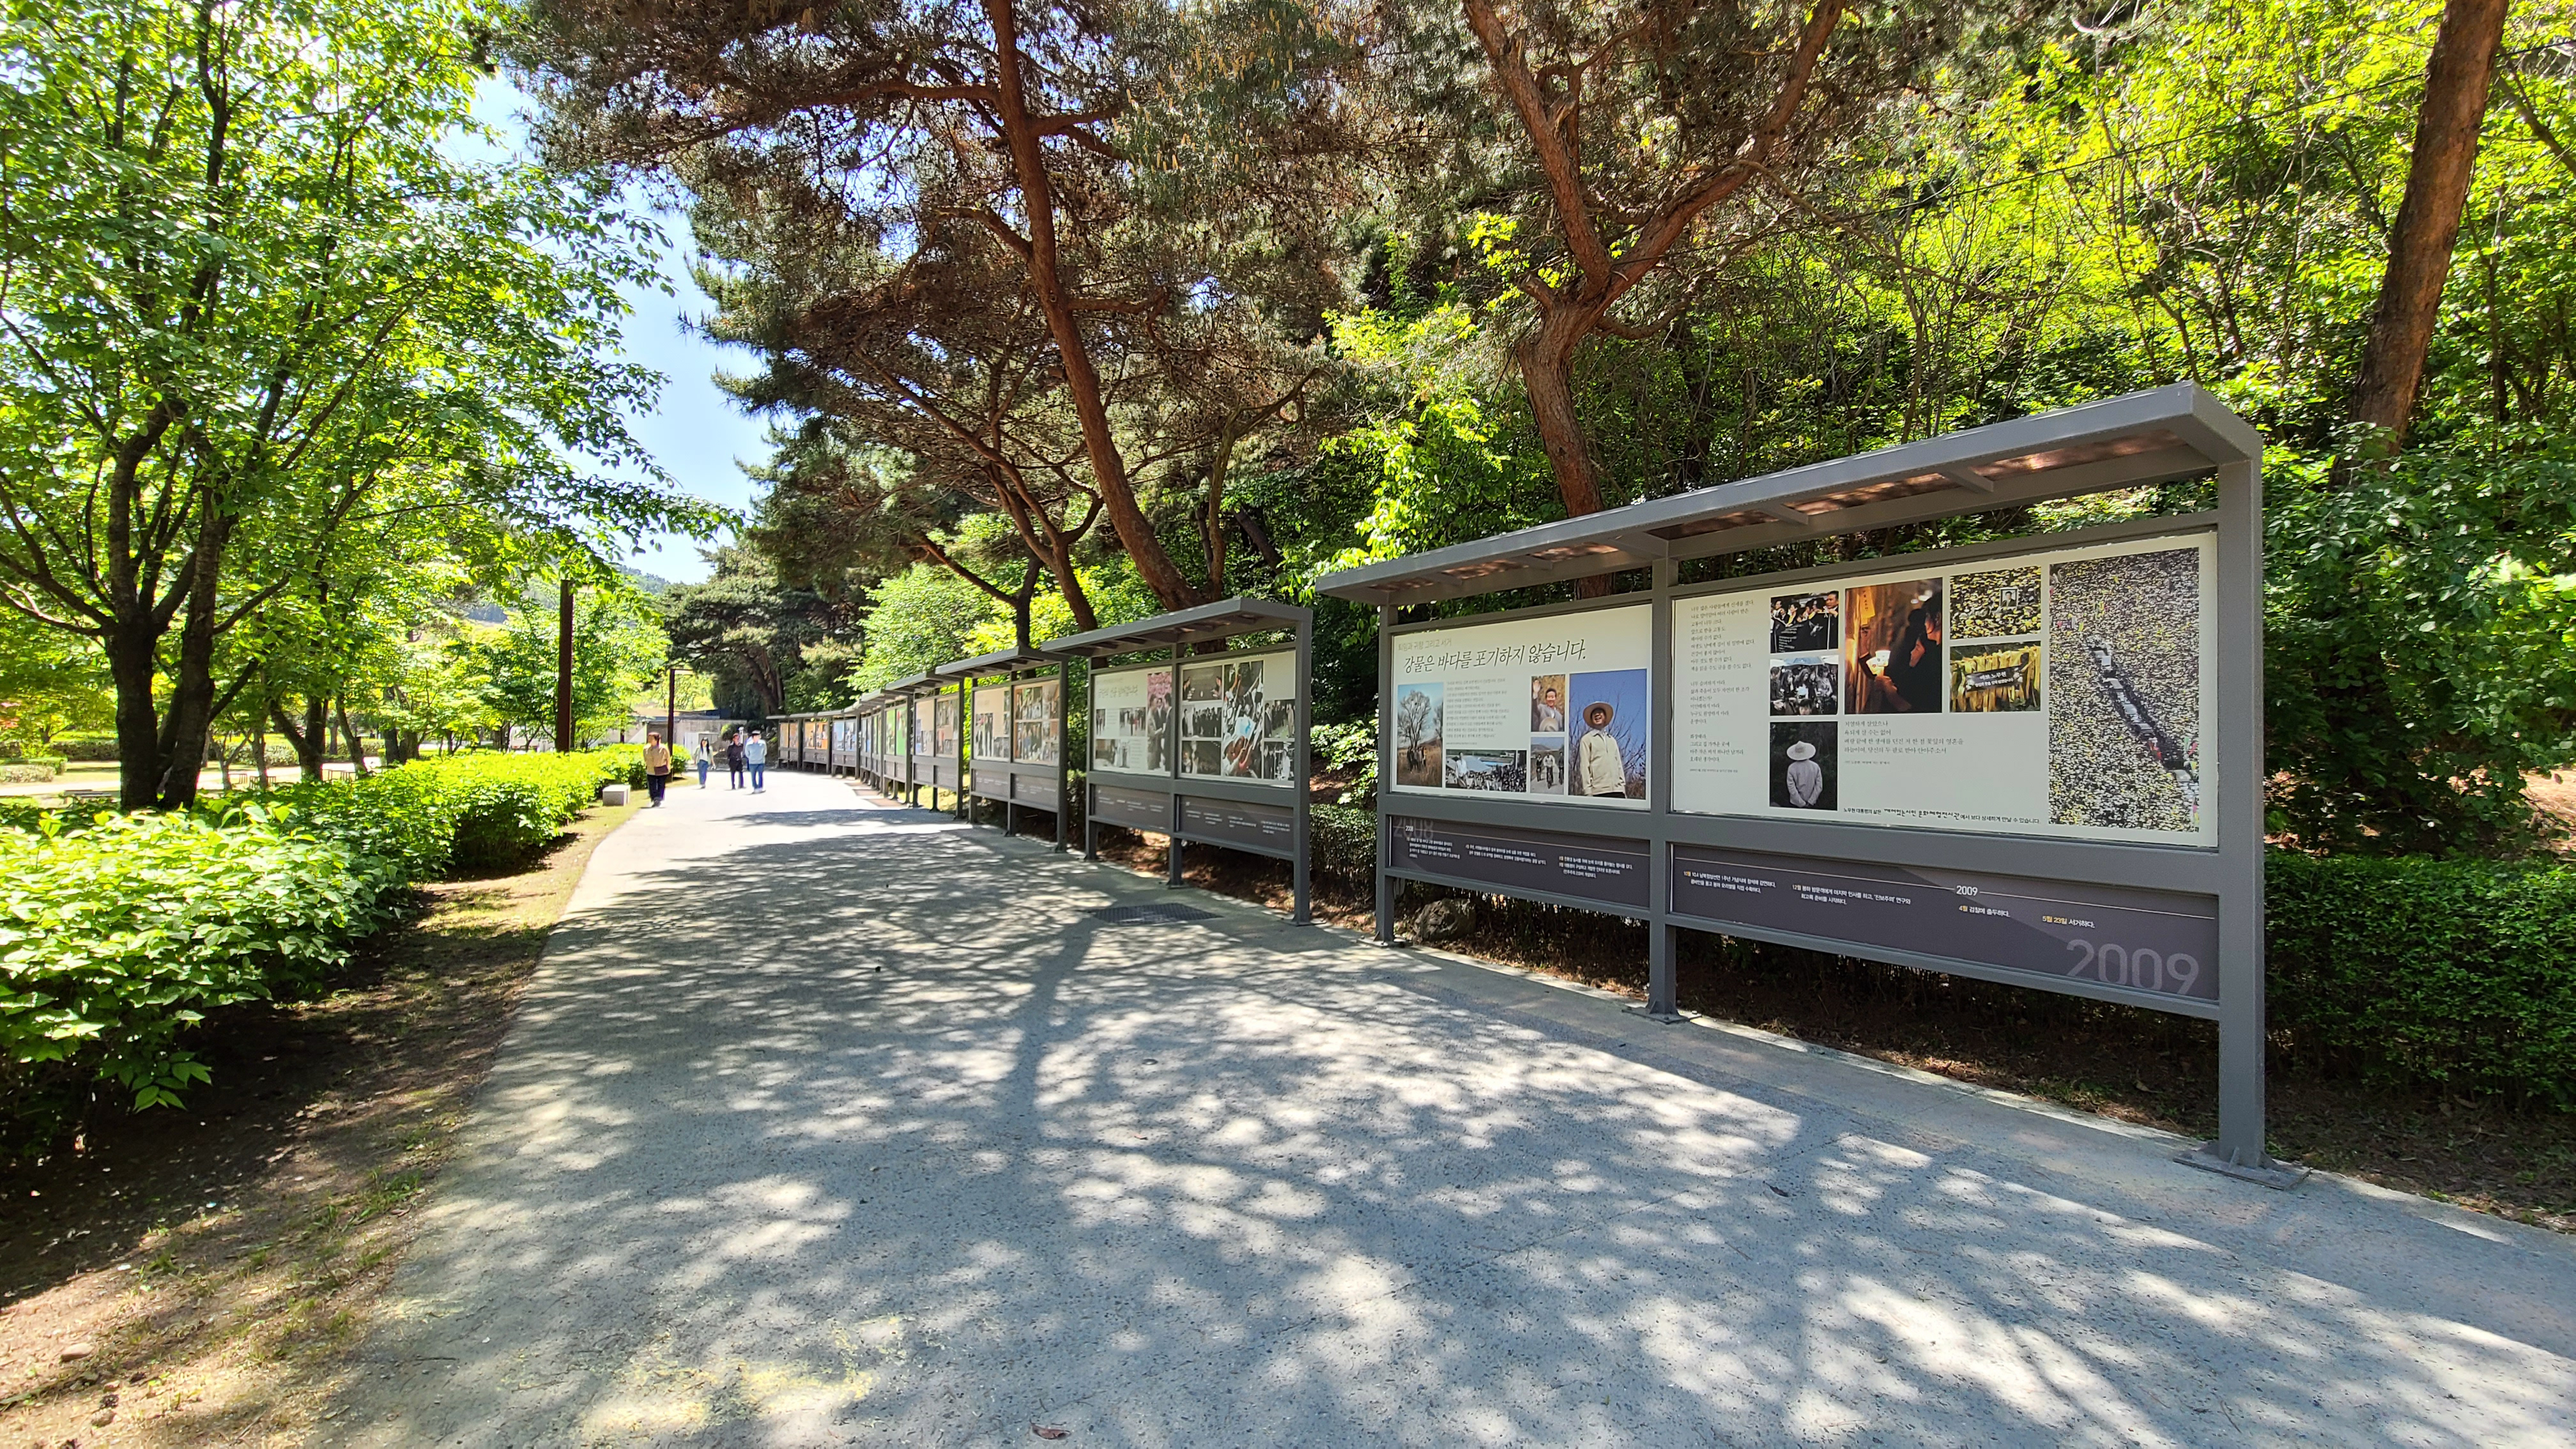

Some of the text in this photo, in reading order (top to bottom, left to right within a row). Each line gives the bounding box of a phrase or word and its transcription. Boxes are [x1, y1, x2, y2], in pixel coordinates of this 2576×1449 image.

[1424, 640, 1439, 648] 그리고
[1404, 639, 1587, 673] 강물은 바다를 포기하지 않습니다.
[1393, 816, 1434, 839] 2008
[1956, 885, 1978, 896] 2009
[2068, 919, 2095, 928] 서거하다.
[2067, 939, 2199, 995] 2009
